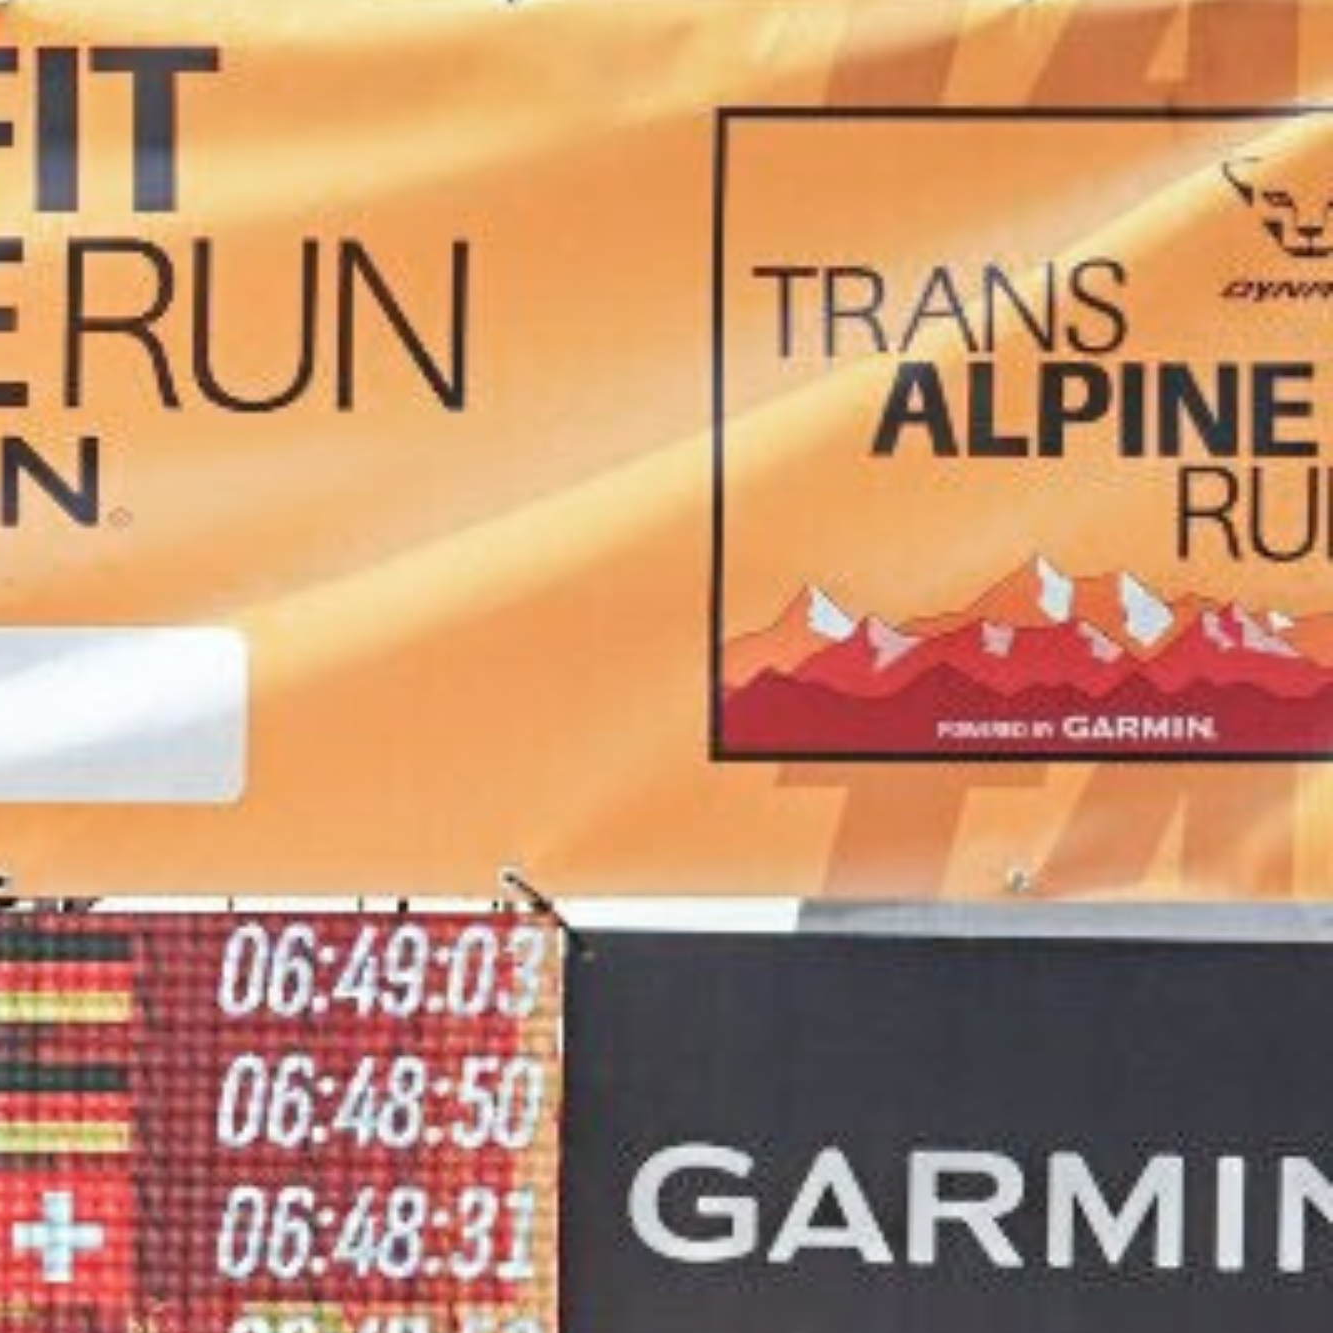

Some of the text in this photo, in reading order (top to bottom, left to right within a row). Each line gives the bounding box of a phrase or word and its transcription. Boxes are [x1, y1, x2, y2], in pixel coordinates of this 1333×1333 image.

[753, 258, 1128, 358] TRANS
[871, 361, 1318, 459] ALPINE
[1177, 466, 1333, 562] RU
[1062, 714, 1217, 741] GARMIN
[220, 922, 545, 1018] 06:49:03
[218, 1053, 545, 1149] 06:48:50
[218, 1185, 537, 1280] 06:48:31
